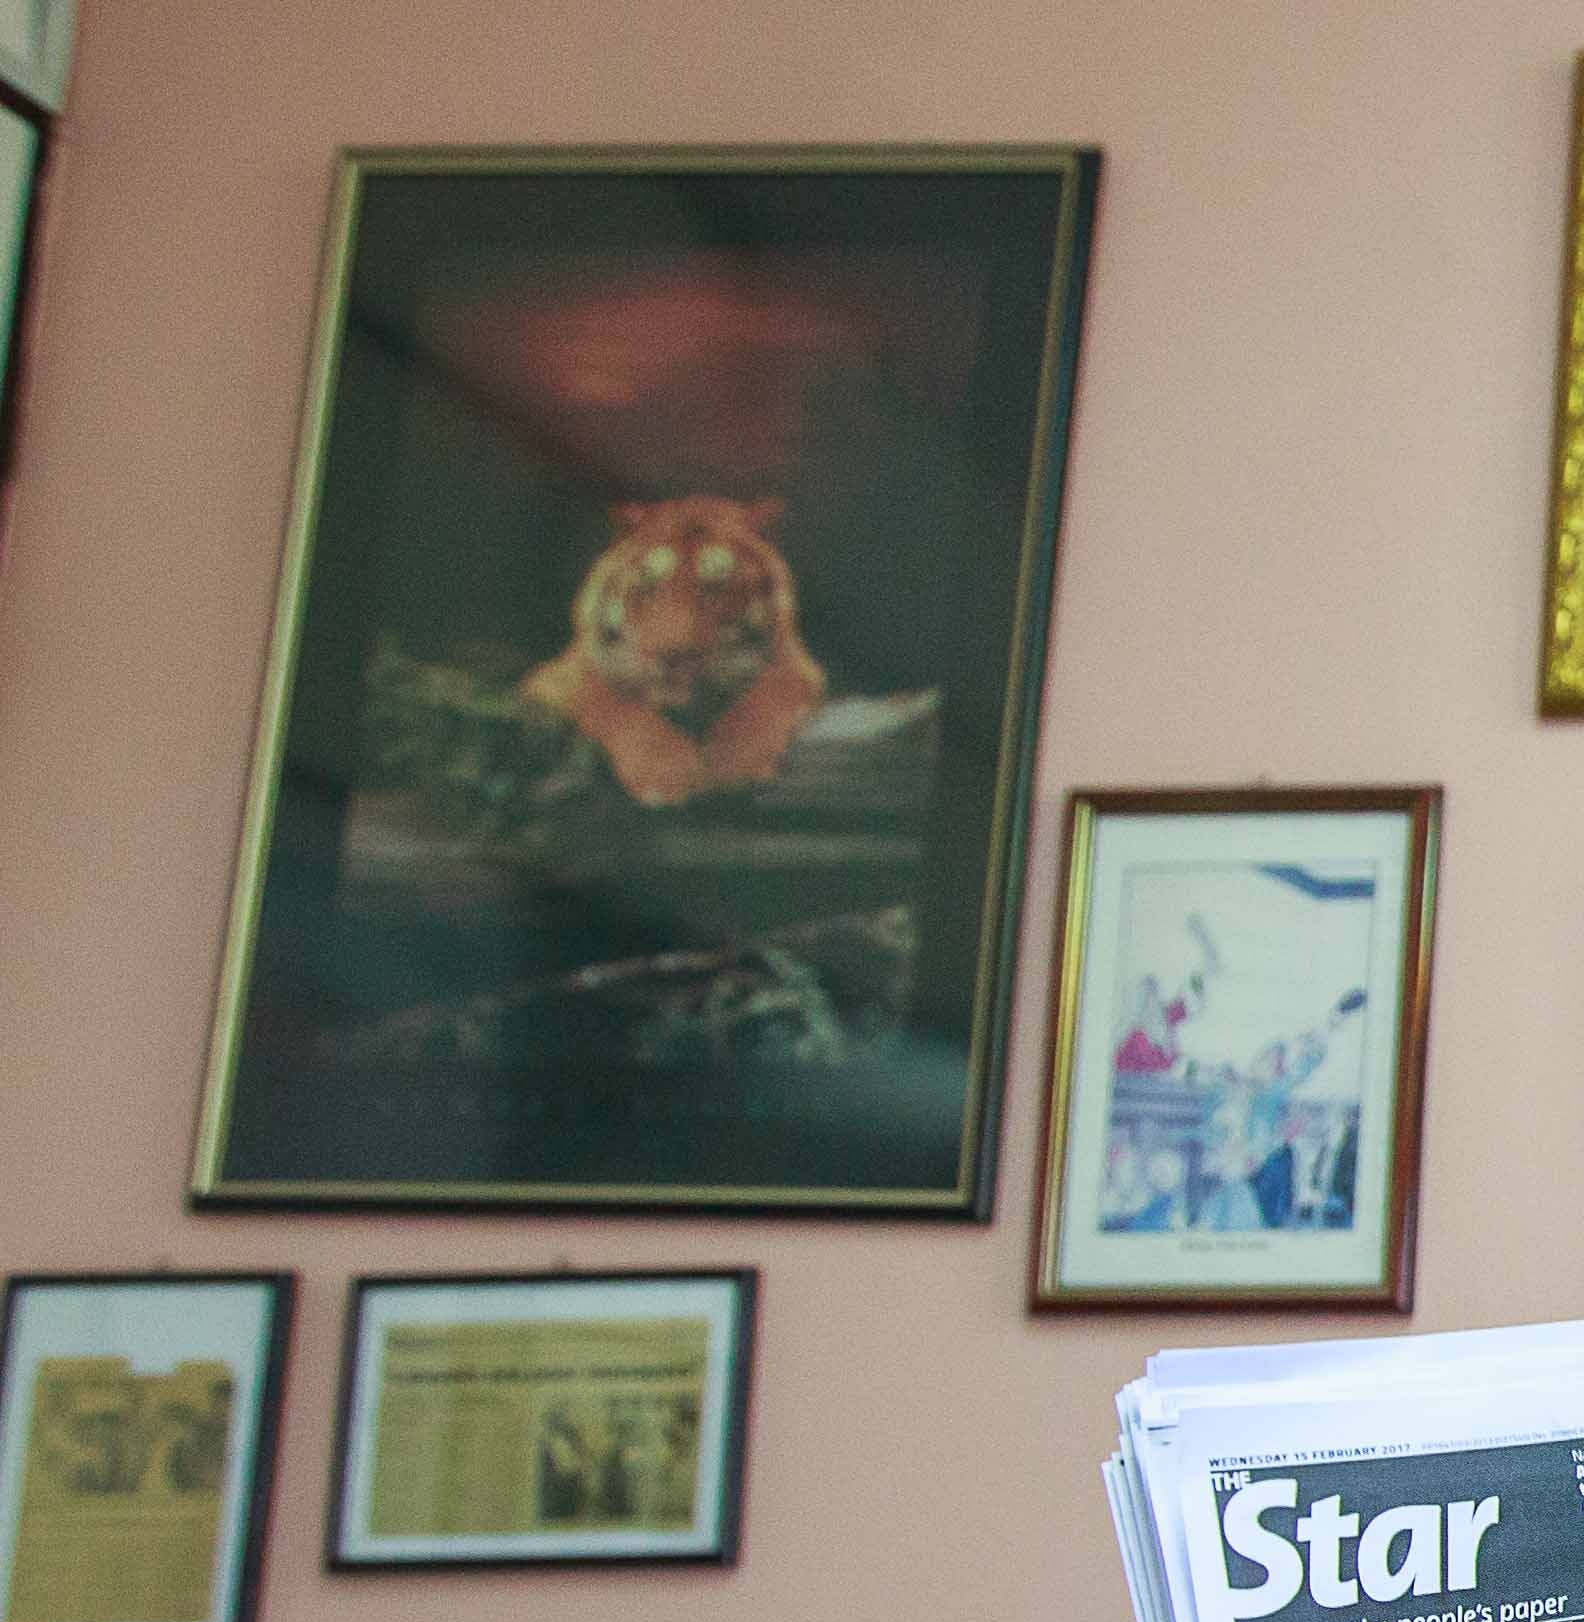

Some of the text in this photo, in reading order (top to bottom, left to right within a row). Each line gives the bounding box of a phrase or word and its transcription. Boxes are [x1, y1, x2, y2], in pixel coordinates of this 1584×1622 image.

[1209, 1454, 1288, 1467] WEDNESDAY
[1295, 1452, 1308, 1461] 15
[1312, 1446, 1376, 1459] FEBRUARY
[1211, 1471, 1250, 1491] THE
[1223, 1477, 1500, 1619] Star
